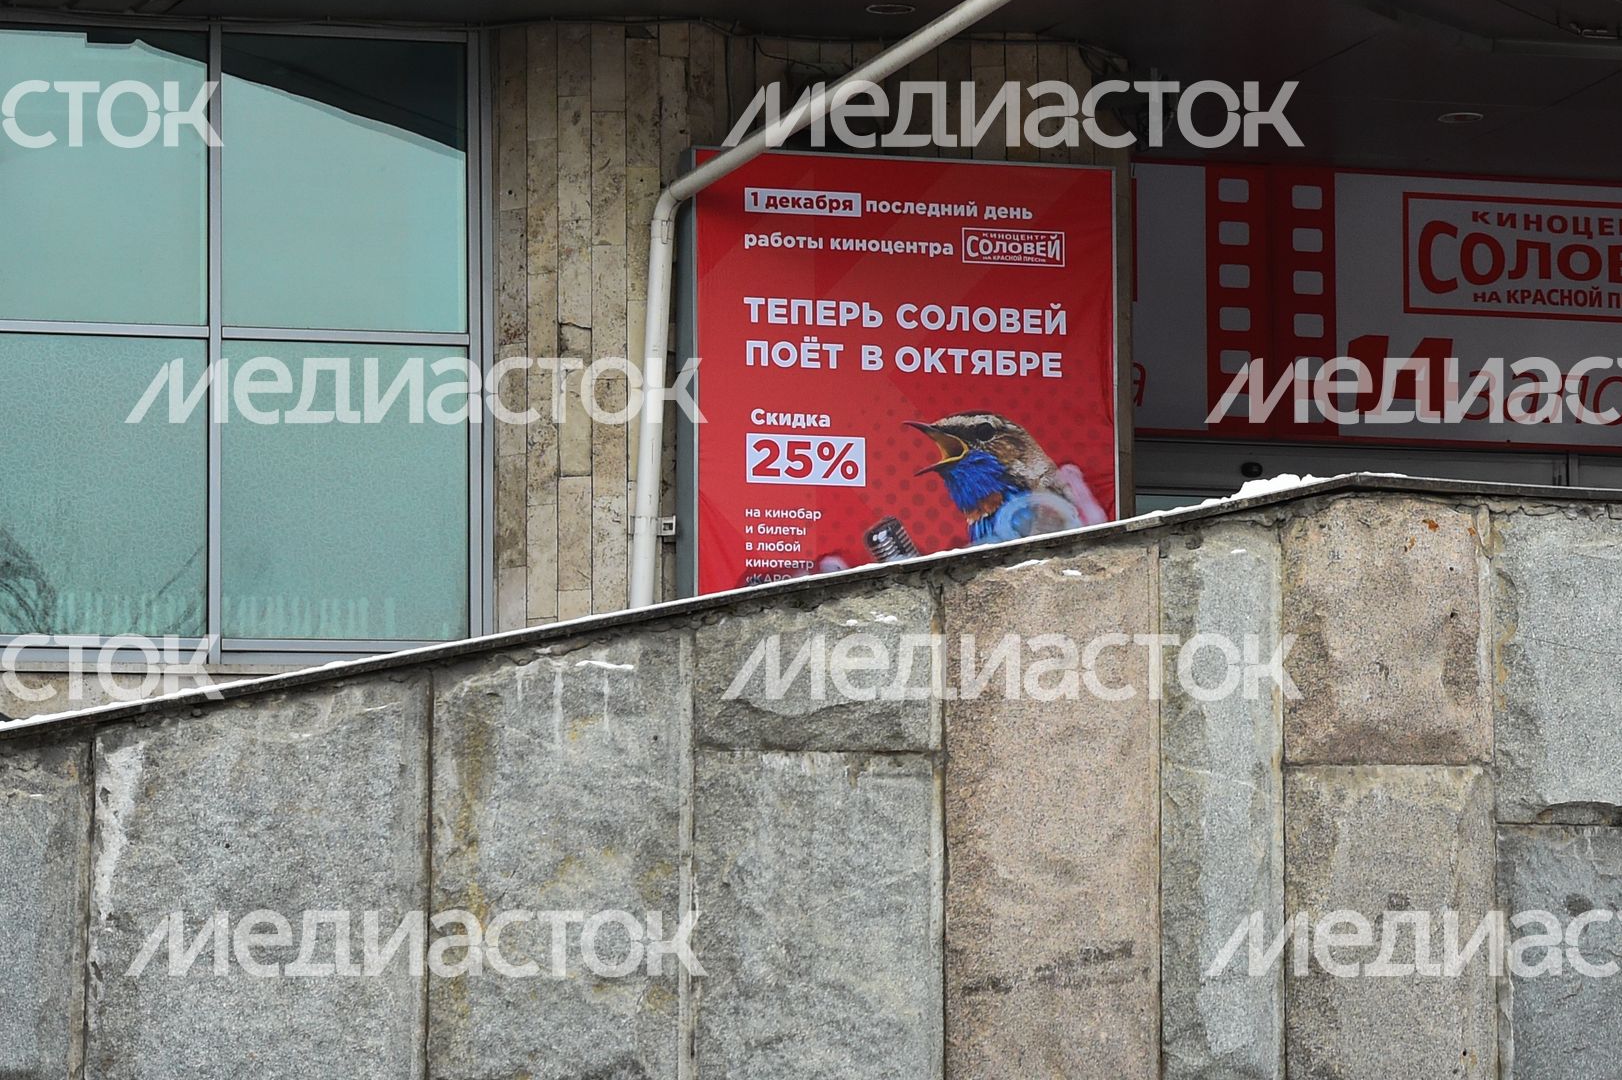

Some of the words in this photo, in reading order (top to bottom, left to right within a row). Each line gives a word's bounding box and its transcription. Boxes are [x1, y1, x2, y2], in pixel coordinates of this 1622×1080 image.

[750, 191, 759, 207] 1
[765, 194, 853, 213] декабря
[866, 199, 978, 218] последний
[984, 205, 1033, 220] день
[745, 232, 824, 250] работы
[830, 237, 954, 257] киноцентра
[966, 234, 1061, 261] СОЛОВЕЙ
[1473, 291, 1501, 303] НА
[1507, 286, 1602, 308] КРАСНОЙ
[744, 297, 883, 328] ТЕПЕРЬ
[896, 303, 1067, 335] СОЛОВЕЙ
[745, 337, 844, 370] ПОЁТ
[862, 345, 883, 371] В
[895, 347, 1063, 378] ОКТЯБРЕ
[751, 408, 831, 428] Скидка
[751, 438, 860, 481] 25%
[745, 508, 761, 518] на
[765, 508, 822, 522] кинобар
[745, 525, 753, 534] и
[757, 523, 807, 536] билеты
[745, 542, 753, 551] в
[756, 540, 801, 552] любой
[745, 558, 814, 571] кинотеатр
